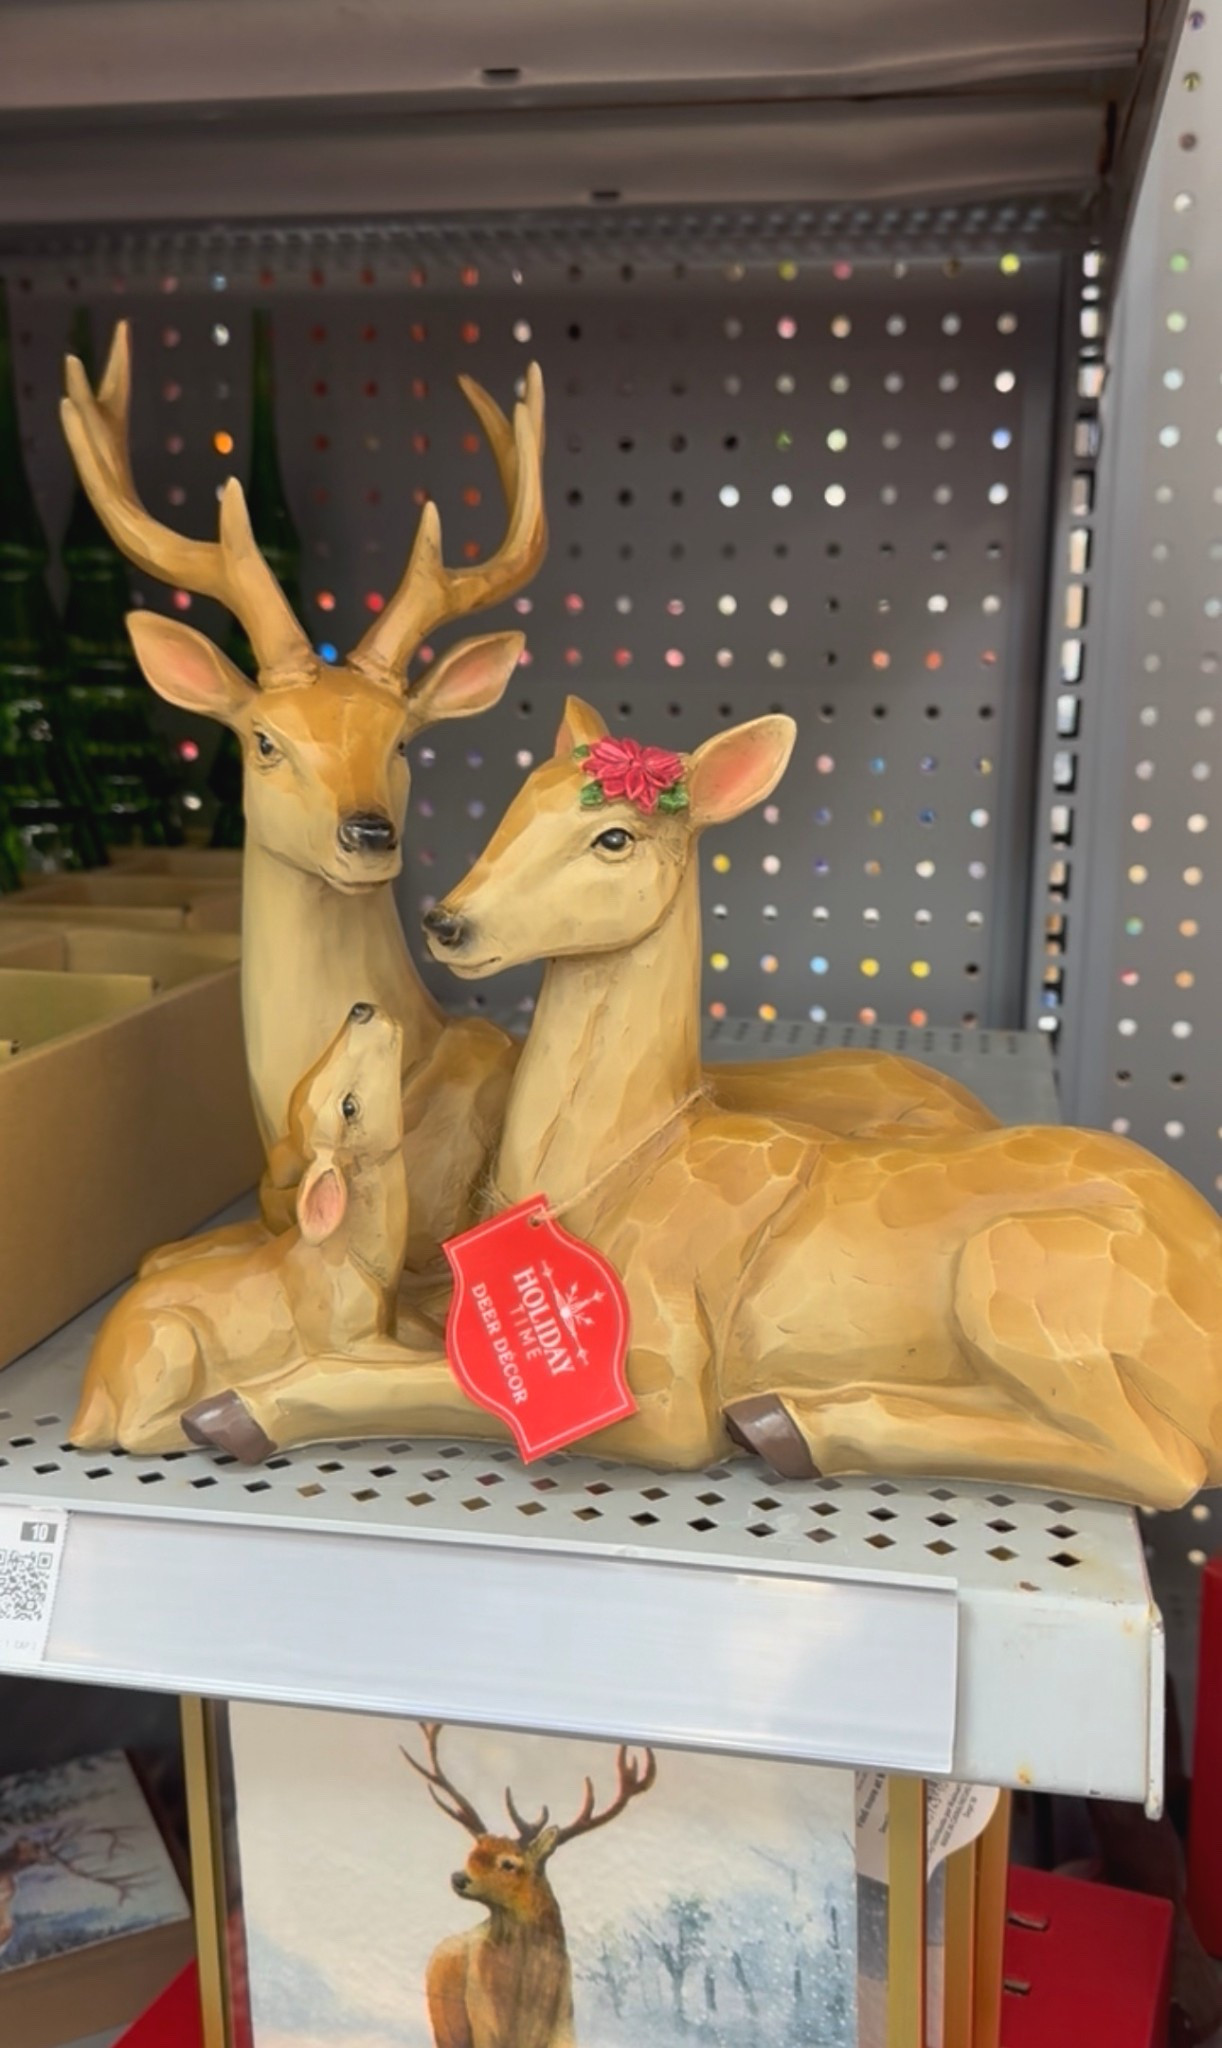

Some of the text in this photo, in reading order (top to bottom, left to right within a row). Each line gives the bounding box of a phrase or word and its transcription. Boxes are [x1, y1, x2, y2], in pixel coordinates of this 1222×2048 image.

[471, 1282, 502, 1335] DEER
[510, 1304, 542, 1361] TIME
[513, 1266, 575, 1376] HOLIDAY
[32, 1524, 48, 1541] 10
